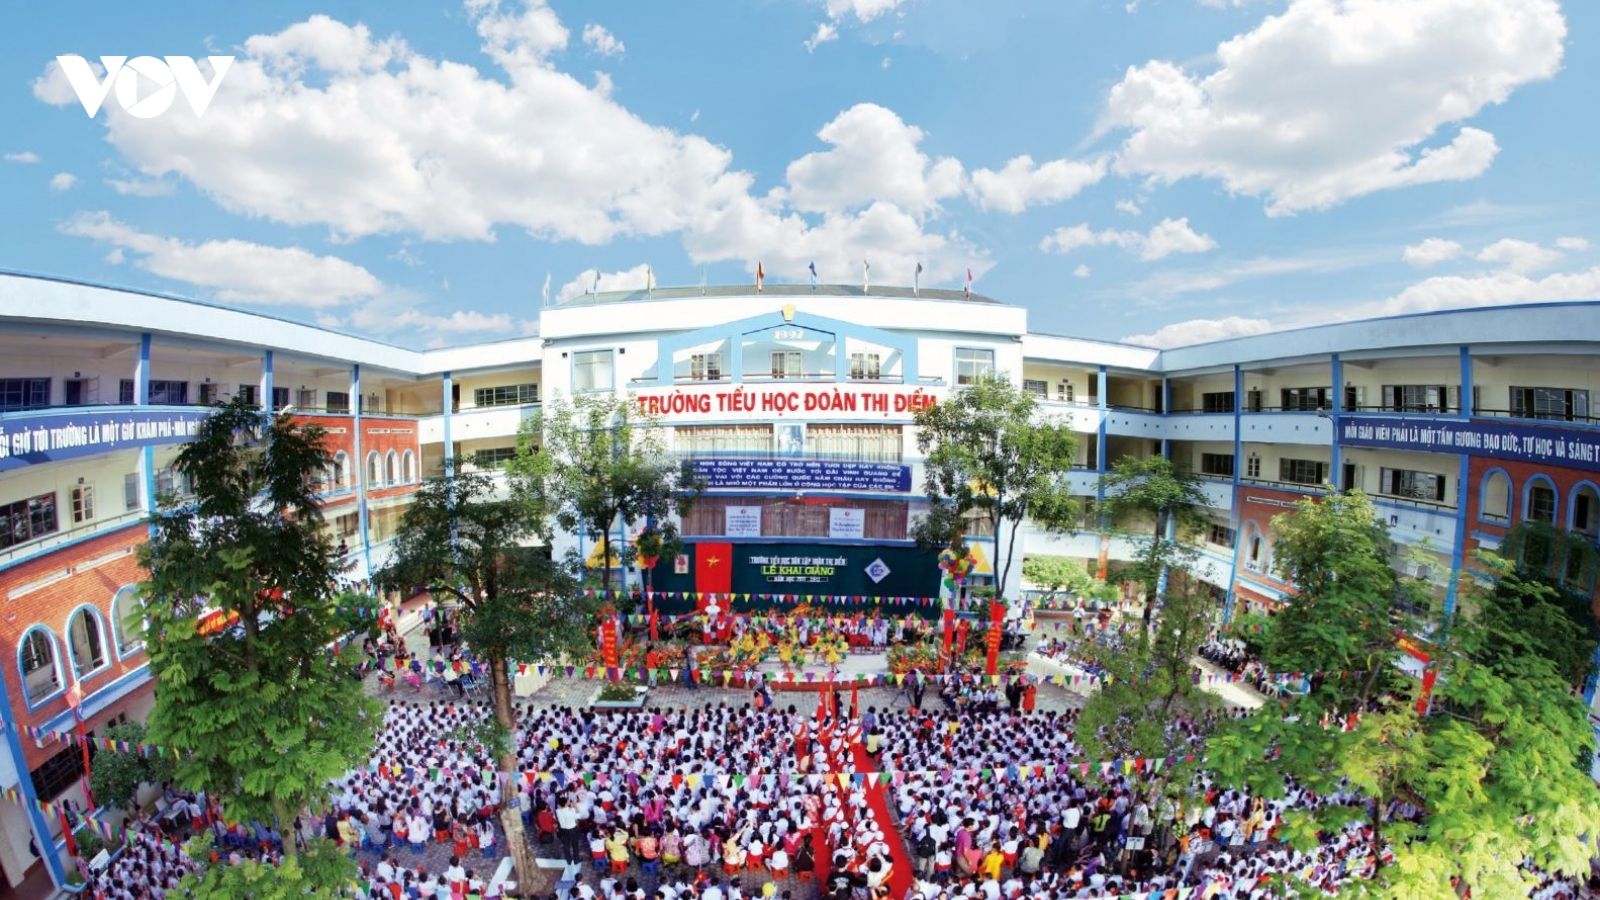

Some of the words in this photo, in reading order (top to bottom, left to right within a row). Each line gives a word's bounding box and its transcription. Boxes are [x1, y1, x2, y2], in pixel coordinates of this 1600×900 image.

[638, 390, 710, 415] TRƯỜNG
[716, 386, 756, 411] TIỂU
[762, 392, 799, 416] HỌC
[804, 388, 856, 411] ĐOÀN
[861, 393, 888, 416] THỊ
[894, 388, 936, 412] ĐIỂM
[12, 426, 31, 456] GIỜ
[33, 426, 48, 452] TỚI
[50, 422, 87, 449] TRƯỜNG
[89, 421, 100, 444] LÀ
[102, 420, 120, 446] MỘT
[122, 418, 134, 440] GIỜ
[136, 418, 157, 440] KHÁM
[1345, 420, 1356, 438] MỖI
[1358, 423, 1374, 440] GIÁO
[1375, 424, 1390, 440] VIÊN
[1392, 422, 1408, 442] PHẢI
[1410, 426, 1418, 442] LÀ
[1420, 426, 1435, 447] MỘT
[1436, 426, 1453, 446] TẤM
[1455, 431, 1481, 448] GƯƠNG
[1484, 434, 1499, 453] ĐẠO
[1502, 432, 1520, 454] ĐỨC,
[1523, 436, 1535, 458] TỰ
[1536, 438, 1552, 459] HỌC
[1555, 436, 1565, 458] VÀ
[1569, 438, 1592, 462] SÁNG
[1594, 445, 1600, 462] T
[763, 564, 776, 574] LỄ
[805, 564, 834, 575] GIẢNG
